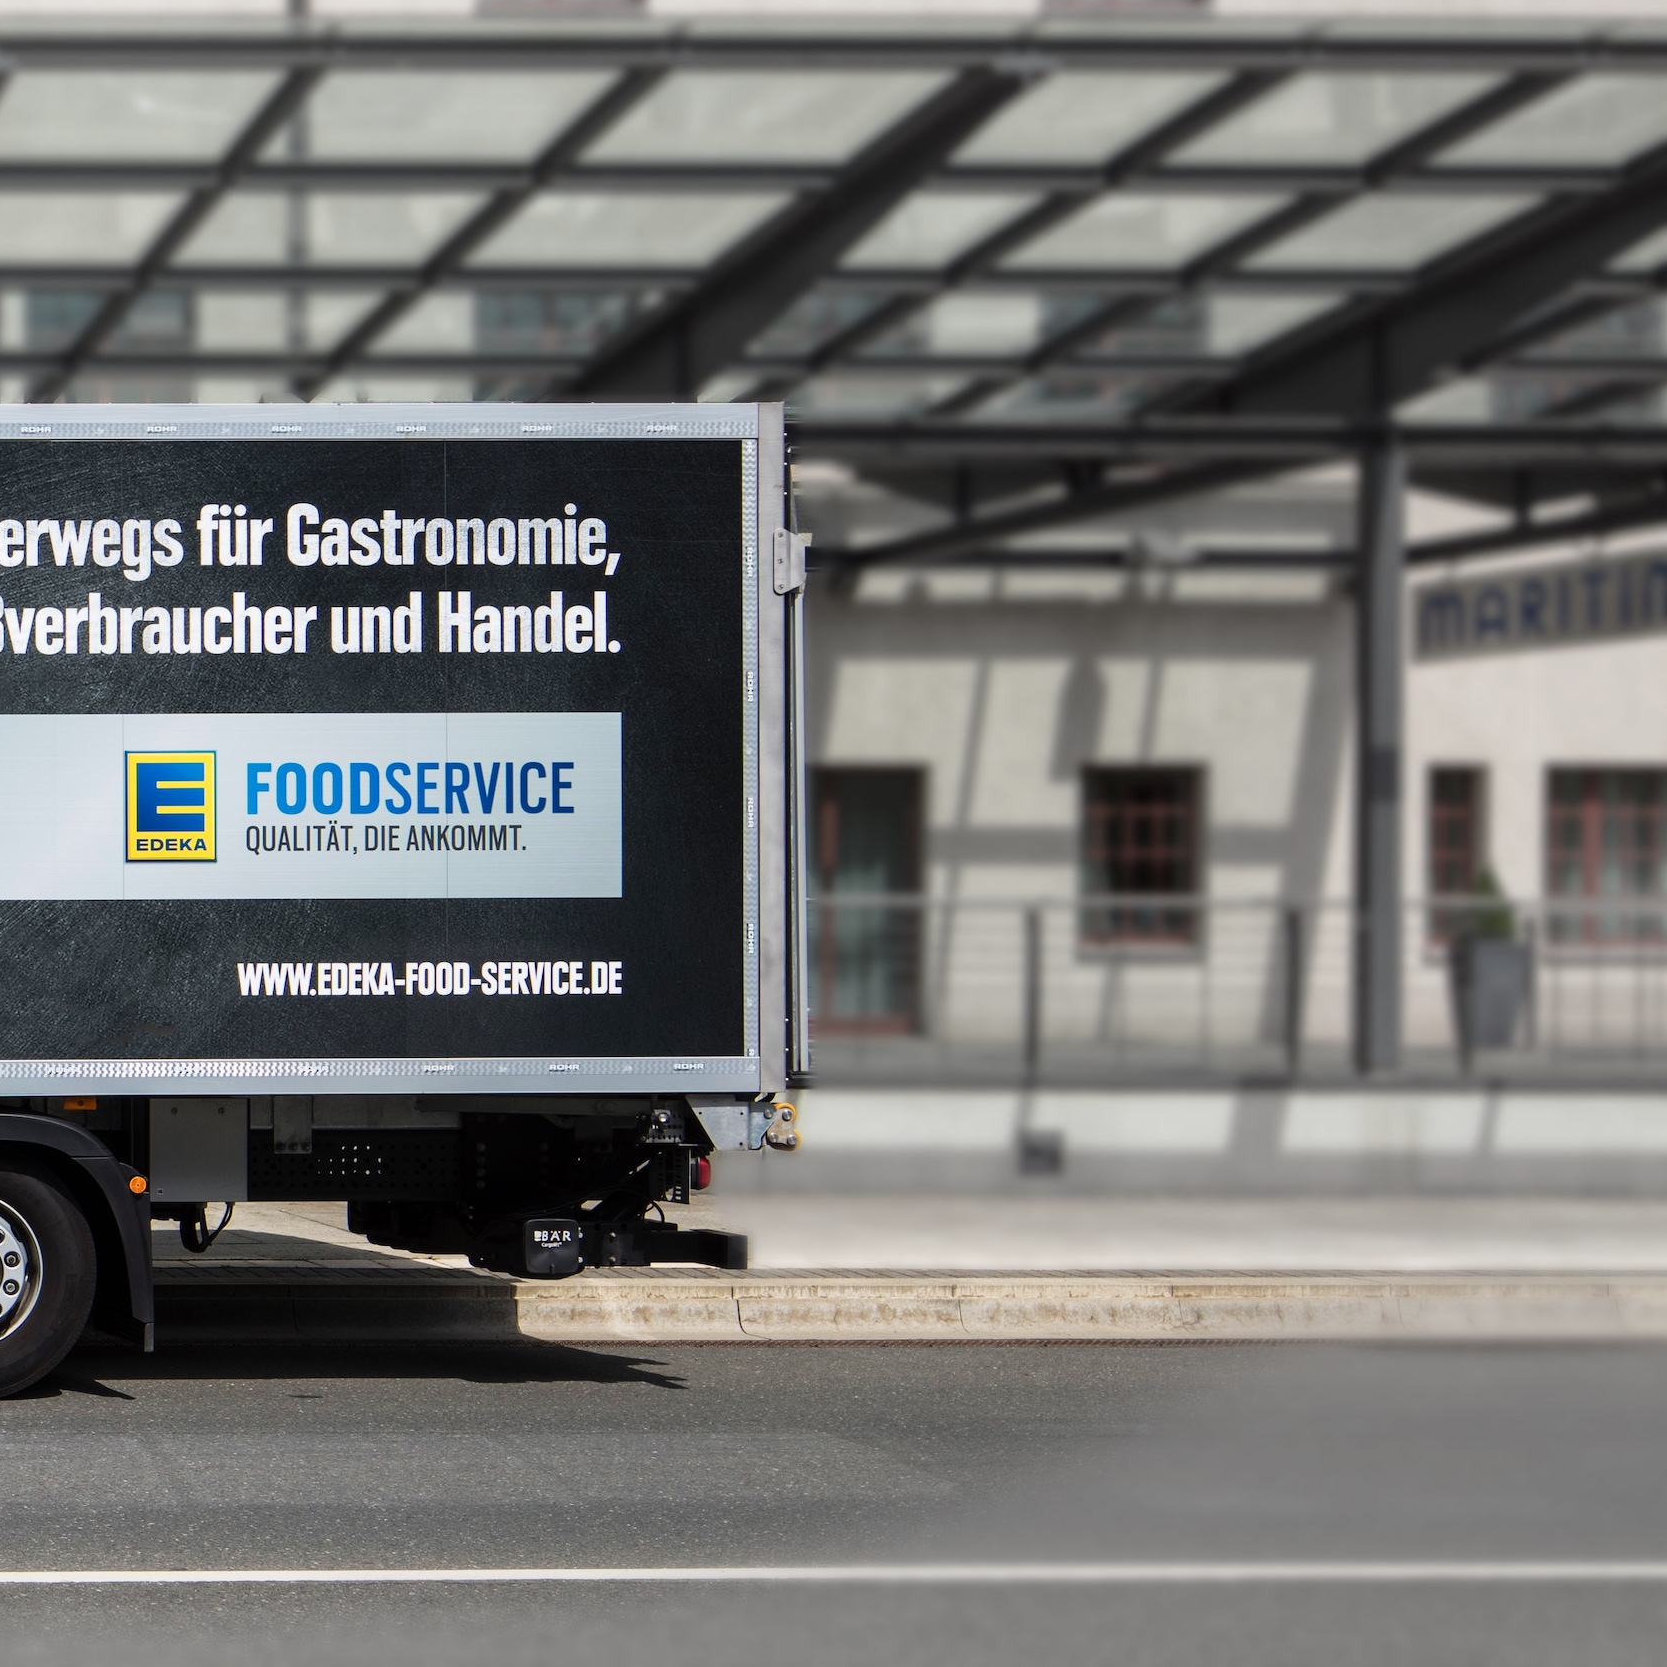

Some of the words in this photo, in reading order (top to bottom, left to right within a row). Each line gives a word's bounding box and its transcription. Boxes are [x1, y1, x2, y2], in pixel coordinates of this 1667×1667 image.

[20, 426, 52, 434] ROHR
[145, 425, 177, 433] ROHR
[270, 425, 302, 433] ROHR
[395, 425, 427, 433] ROHR
[521, 424, 553, 432] ROHR
[646, 424, 678, 432] ROHR
[197, 504, 274, 567] für
[288, 503, 621, 576] Gastronomie,
[332, 591, 422, 654] und
[439, 590, 621, 654] Handel.
[247, 762, 575, 815] FOODSERVICE
[246, 820, 358, 856] QUALITÄT,
[364, 825, 400, 852] DIE
[406, 824, 527, 852] ANKOMMT.
[136, 838, 207, 852] EDEKA
[237, 960, 623, 997] WWW.EDEKA-FOOD-SERVICE.DE
[548, 1063, 581, 1071] ROHR
[672, 1063, 705, 1071] ROHR
[541, 1230, 571, 1242] BÄR
